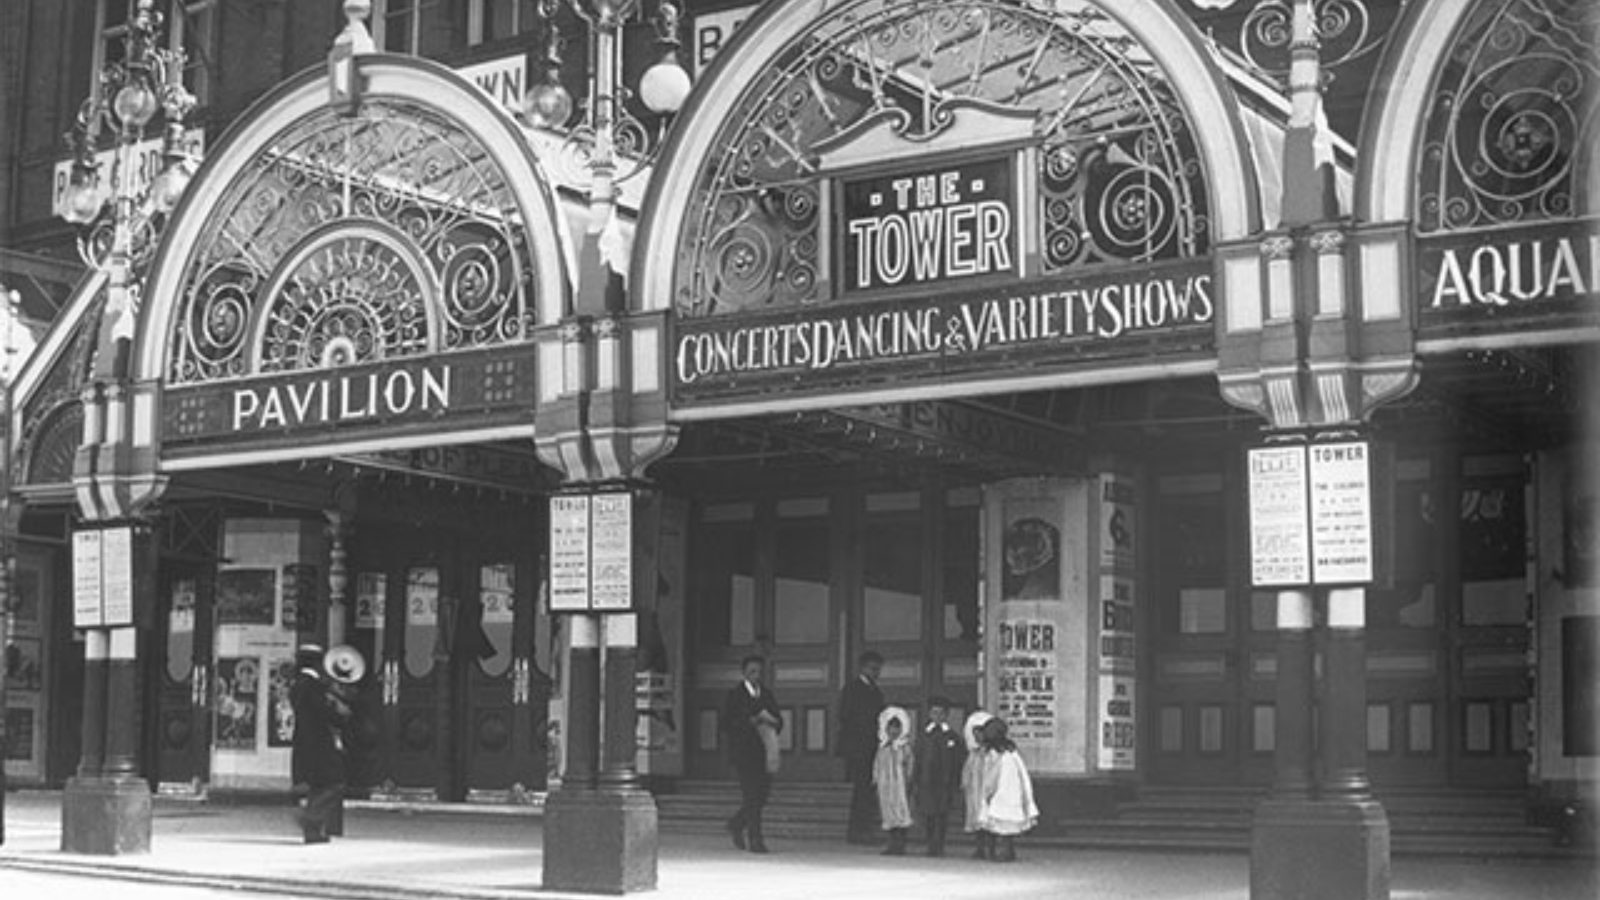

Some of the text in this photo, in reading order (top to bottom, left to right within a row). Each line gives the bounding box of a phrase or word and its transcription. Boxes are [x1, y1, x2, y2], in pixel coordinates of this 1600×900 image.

[699, 21, 742, 66] B
[893, 171, 960, 209] THE
[849, 201, 1011, 288] TOWER
[677, 275, 1212, 383] CONCERTS DANCING & VARIETY SHOWS
[233, 365, 450, 431] PAVILION
[1314, 446, 1363, 463] TOWER
[999, 622, 1053, 653] TOWER
